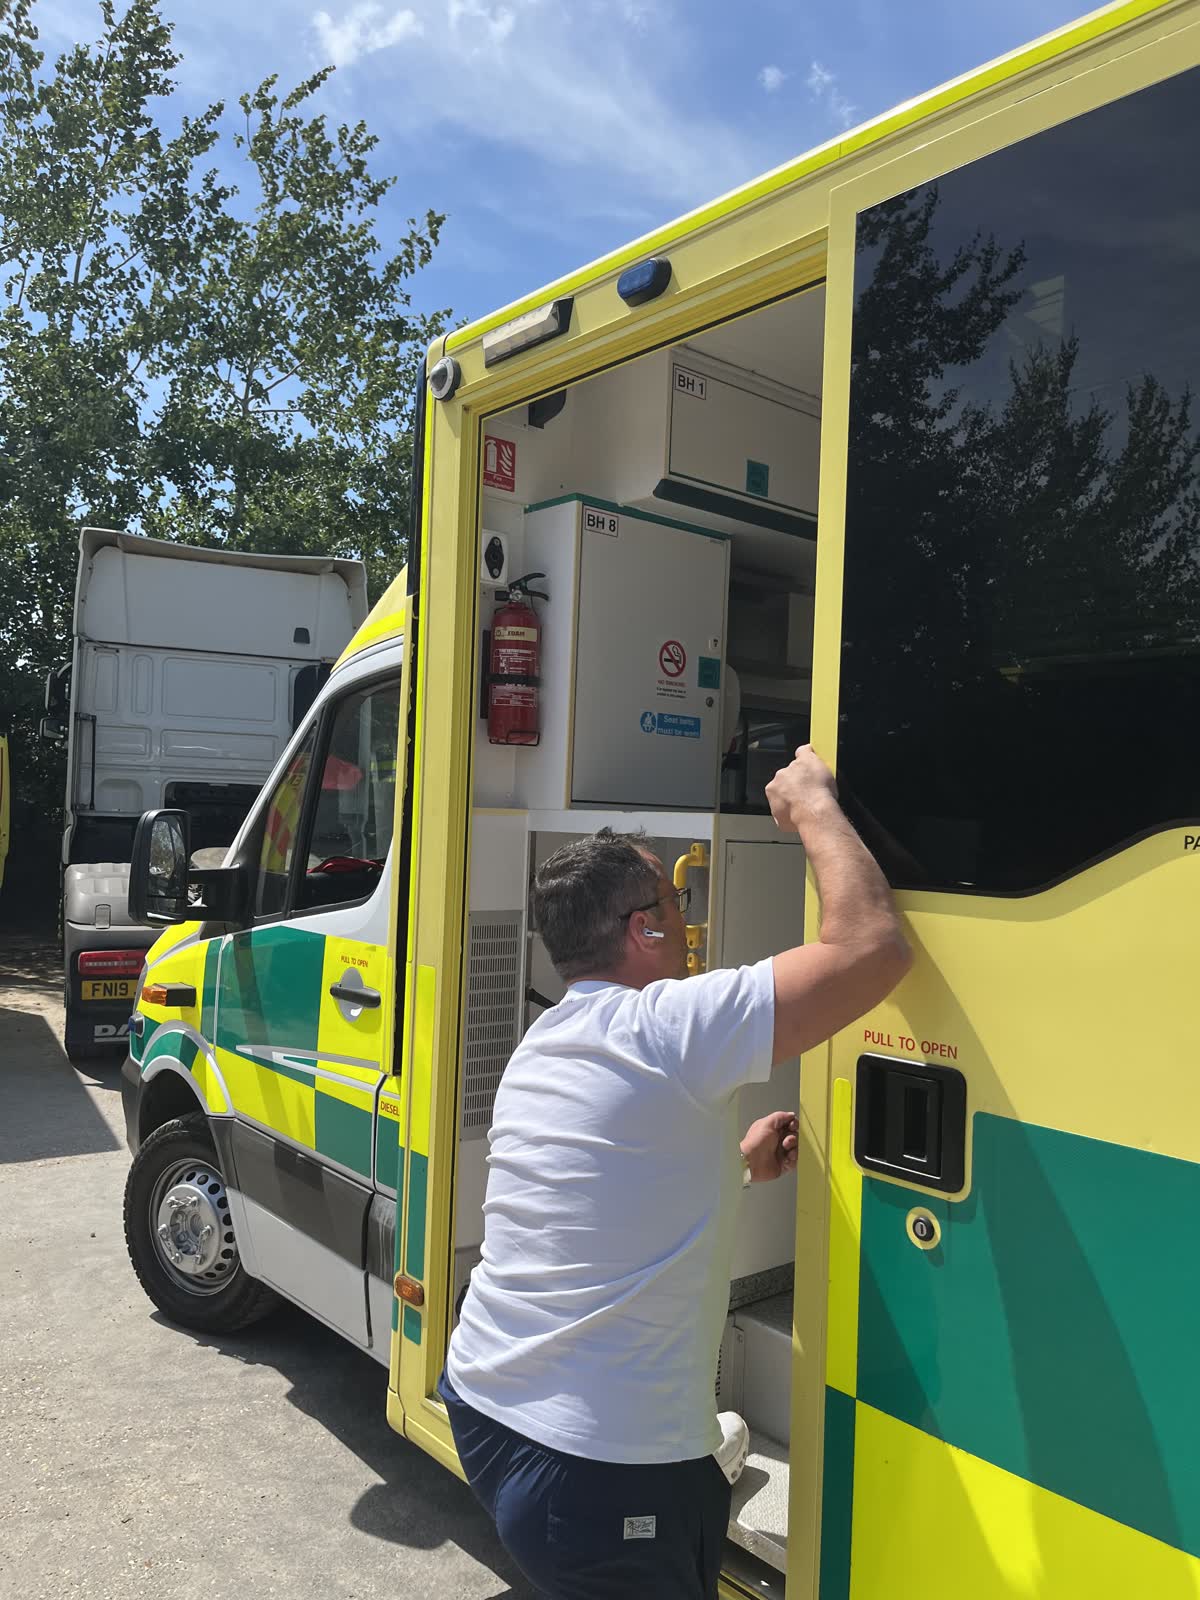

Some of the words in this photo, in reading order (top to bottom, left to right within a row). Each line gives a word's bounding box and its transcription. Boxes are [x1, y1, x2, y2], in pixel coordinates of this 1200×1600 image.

[677, 373, 695, 392] BH
[698, 381, 705, 396] 1
[586, 513, 605, 530] BH
[608, 519, 617, 533] 8
[340, 955, 350, 964] PULL
[350, 957, 357, 965] TO
[357, 958, 369, 968] OPEN
[91, 982, 129, 997] FN19
[94, 1024, 130, 1037] DA
[863, 1029, 894, 1047] PULL
[898, 1036, 916, 1052] TO
[920, 1040, 958, 1060] OPEN
[380, 1100, 400, 1117] DIESEL
